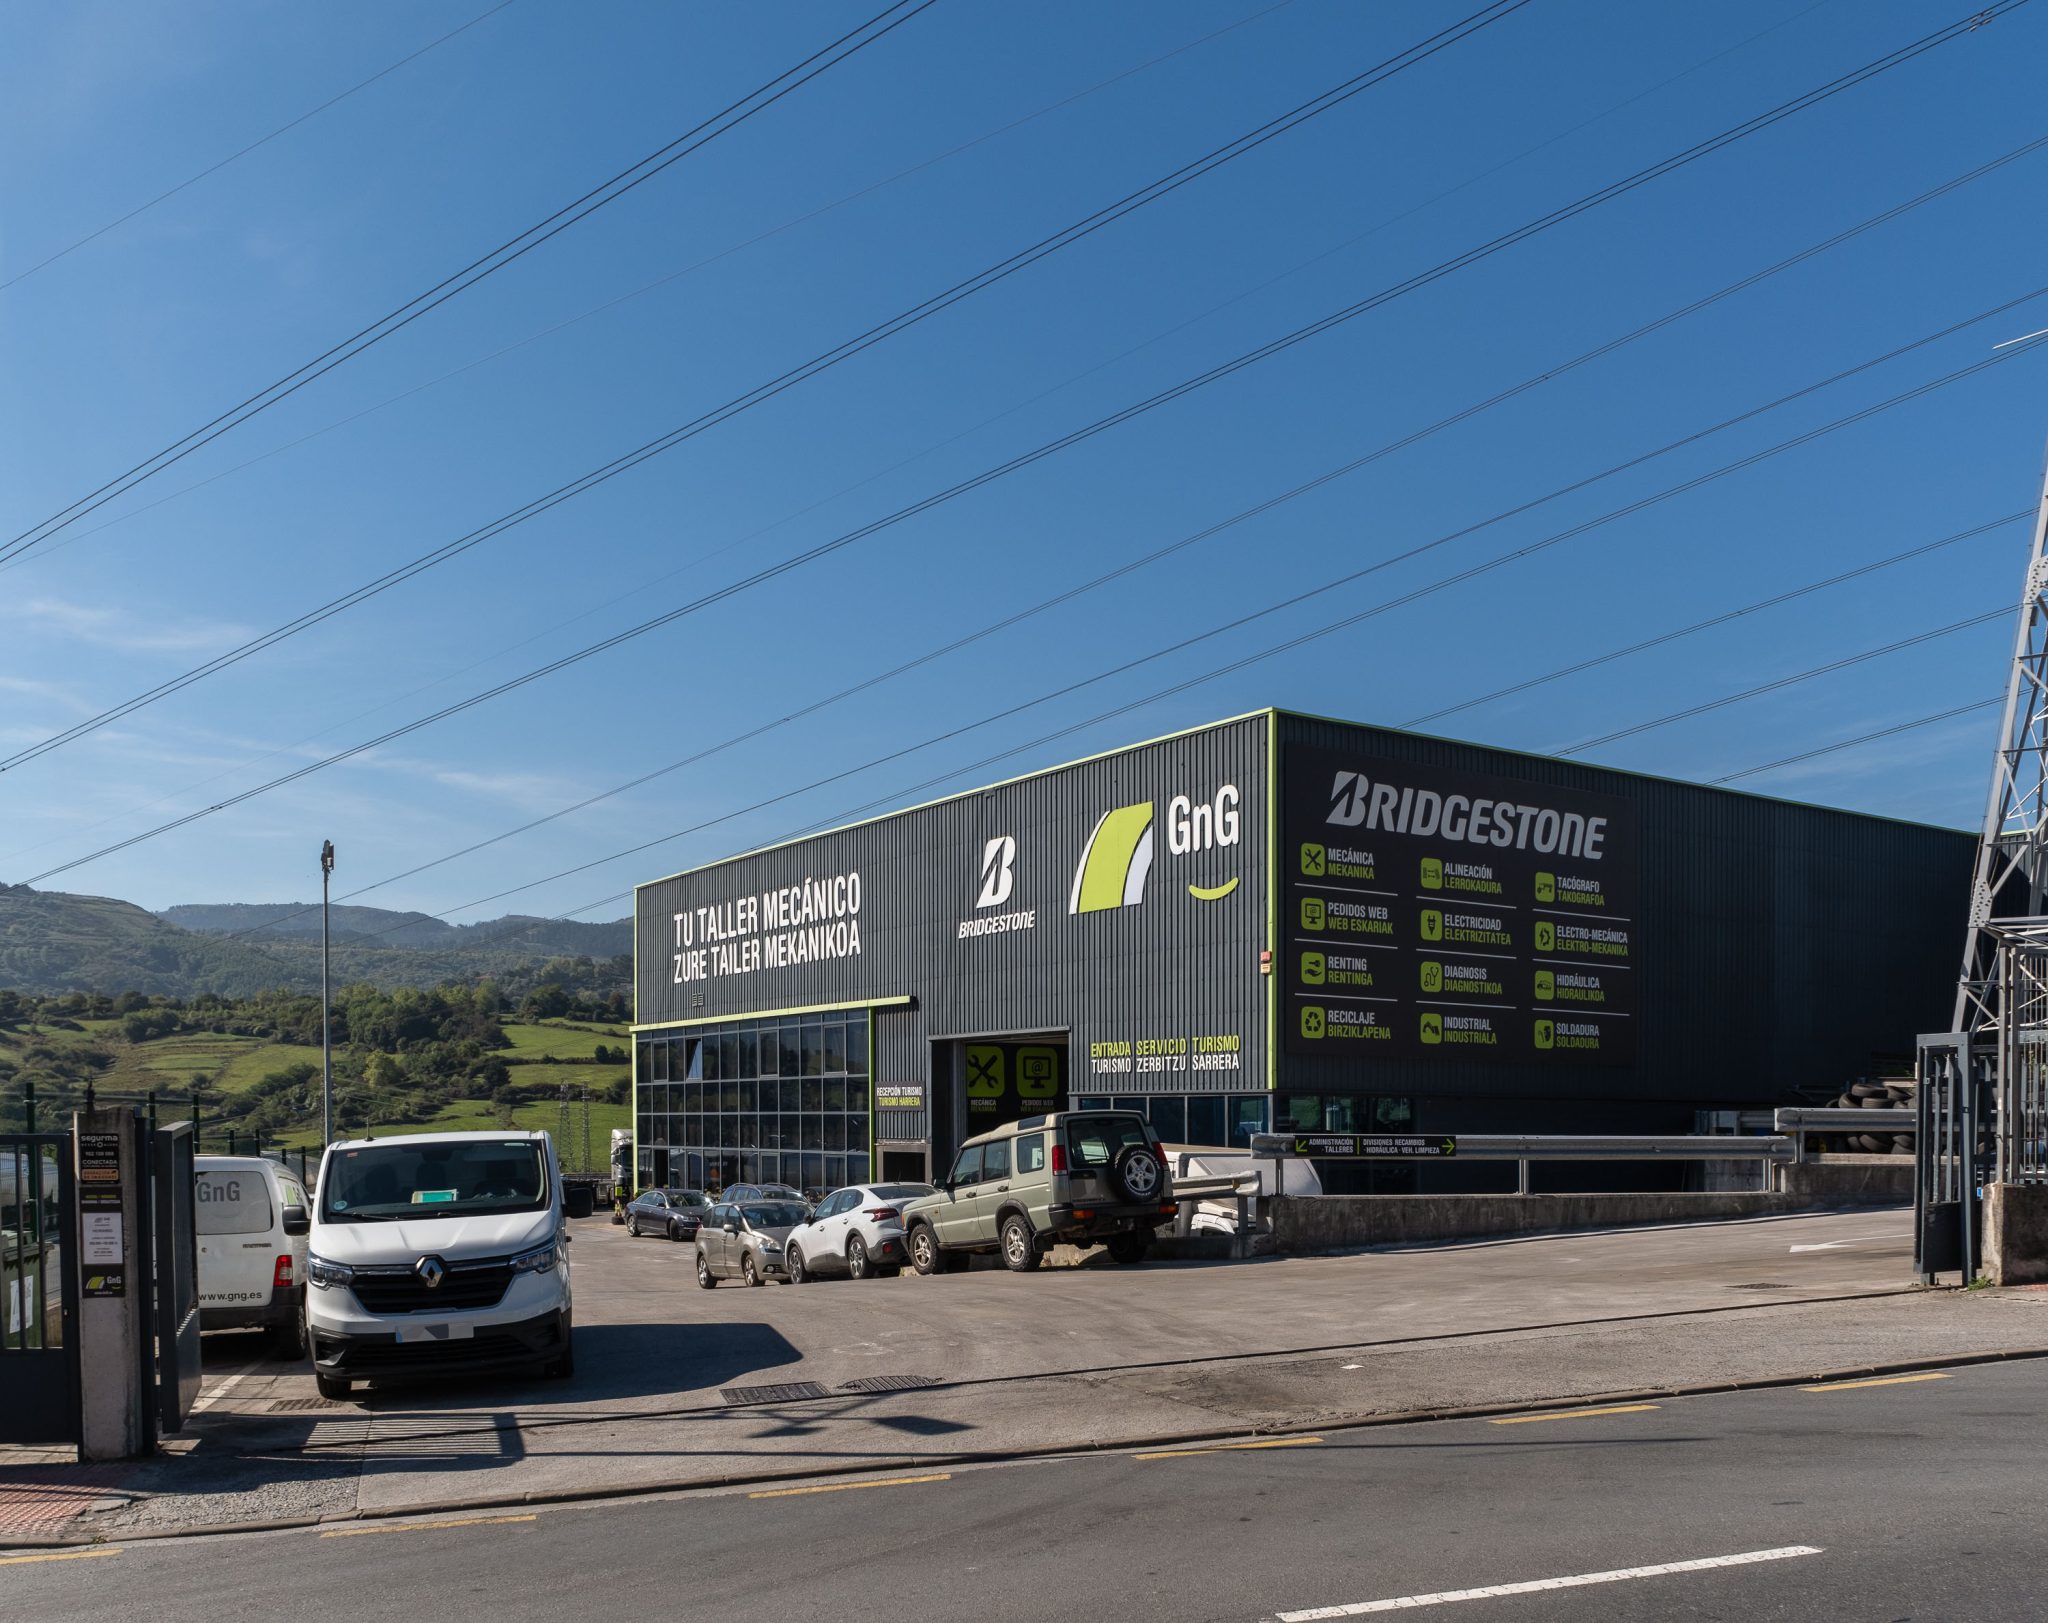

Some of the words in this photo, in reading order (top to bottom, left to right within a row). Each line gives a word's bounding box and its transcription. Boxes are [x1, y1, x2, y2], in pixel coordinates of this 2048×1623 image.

[1168, 784, 1240, 855] GnG
[1325, 770, 1608, 860] BRIDGESTONE
[1328, 847, 1374, 866] MECÁNICA
[1328, 862, 1374, 880] MEKANIKA
[1444, 862, 1493, 880] ALINEACIÓN
[1444, 876, 1502, 894] LERROKADURA
[1557, 875, 1600, 893] TACÓGRAFO
[1557, 889, 1605, 906] TAKOGRAFOA
[673, 911, 693, 948] TU
[697, 896, 758, 943] TALLER
[763, 872, 861, 931] MECÁNICO
[1328, 902, 1366, 918] PEDIDOS
[1368, 905, 1388, 920] WEB
[958, 910, 1035, 939] BRIDGESTONE
[1328, 916, 1348, 930] WEB
[1350, 918, 1393, 935] ESKARIAK
[1444, 914, 1501, 931] ELECTRICIDAD
[1444, 928, 1511, 945] ELEKTRIZITATEA
[1557, 925, 1628, 943] ELECTRO-MECÁNICA
[673, 949, 707, 984] ZURE
[711, 938, 760, 977] TAILER
[765, 919, 861, 969] MEKANIKOA
[1557, 938, 1628, 956] ELEKTRO-MEKANIKA
[1328, 956, 1367, 971] RENTING
[1328, 970, 1373, 986] RENTINGA
[1444, 965, 1487, 980] DIAGNOSIS
[1556, 973, 1600, 989] HIDRÁULICA
[1444, 979, 1502, 995] DIAGNOSTIKOA
[1556, 987, 1605, 1002] HIDRAULIKOA
[1328, 1010, 1375, 1025] RECICLAJE
[1444, 1016, 1492, 1031] INDUSTRIAL
[1328, 1024, 1391, 1040] BIRZIKLAPENA
[1444, 1030, 1497, 1044] INDUSTRIALA
[1556, 1022, 1599, 1036] SOLDADURA
[1091, 1041, 1131, 1057] ENTRADA
[1136, 1038, 1187, 1056] SERVICIO
[1192, 1035, 1240, 1053] TURISMO
[1556, 1035, 1599, 1049] SOLDADURA
[1091, 1057, 1131, 1074] TURISMO
[1136, 1055, 1186, 1073] ZERBITZU
[1192, 1053, 1240, 1071] SARRERA
[876, 1085, 900, 1096] RECEPCIÓN
[901, 1086, 922, 1096] TURISMO
[879, 1097, 898, 1106] TURISMO
[899, 1096, 920, 1106] HARRERA
[1309, 1137, 1353, 1146] ADMINISTRACIÓN
[1362, 1138, 1393, 1146] DIVISIONES
[1394, 1138, 1425, 1146] RECAMBIOS
[197, 1181, 241, 1202] GnG
[198, 1291, 263, 1302] www.gng.es
